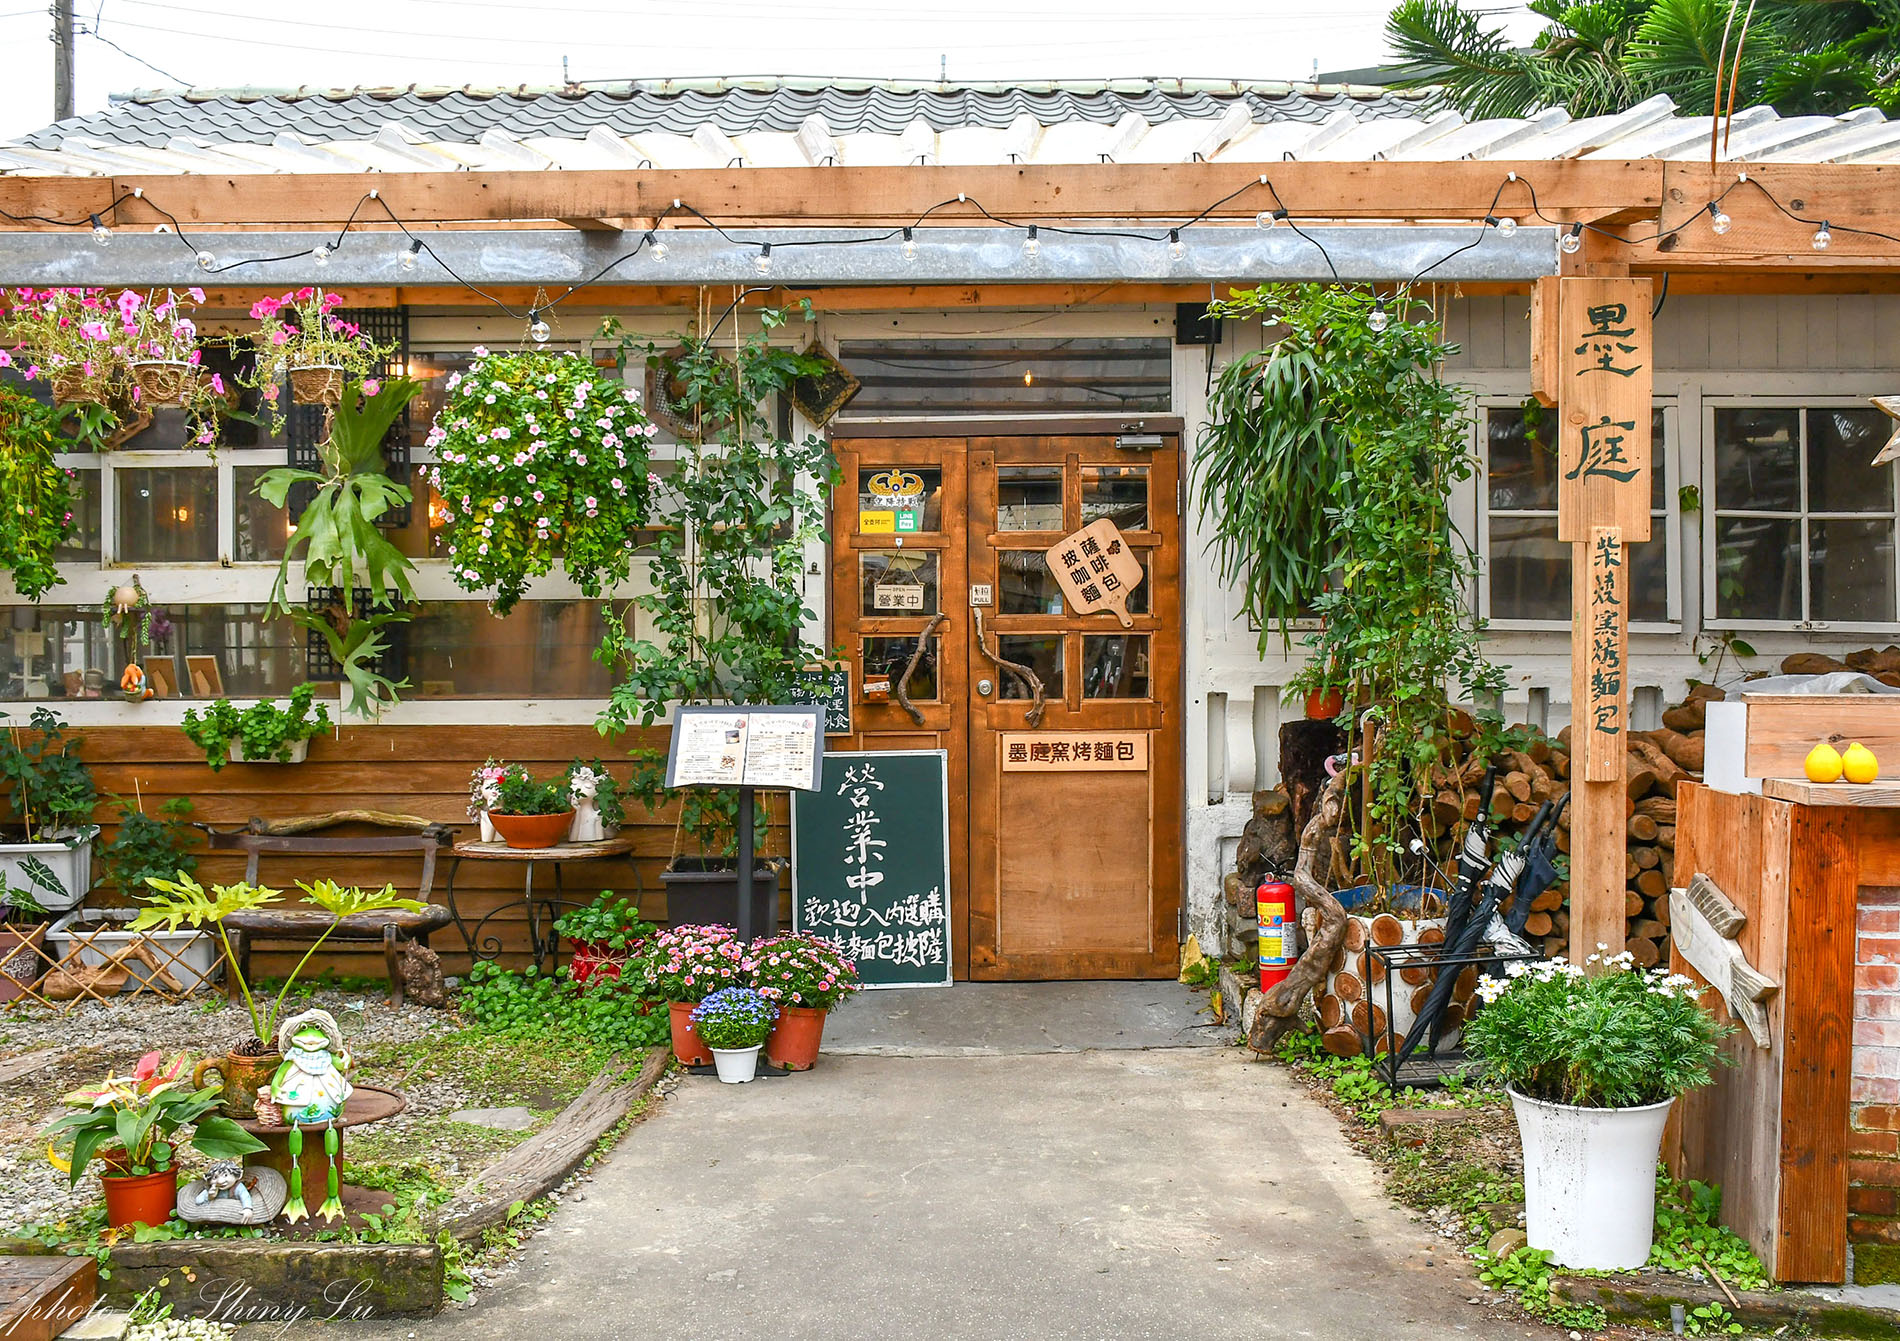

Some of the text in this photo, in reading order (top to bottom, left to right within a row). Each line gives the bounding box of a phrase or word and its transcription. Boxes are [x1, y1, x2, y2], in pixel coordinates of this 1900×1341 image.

[1565, 302, 1642, 486] 墨庭
[1061, 536, 1101, 569] 披薩
[1070, 554, 1109, 585] 咖啡
[879, 594, 919, 607] 營業中
[1080, 572, 1121, 604] 麵包
[1008, 740, 1135, 763] 墨庭窯烤麵包
[837, 762, 887, 905] 營業中
